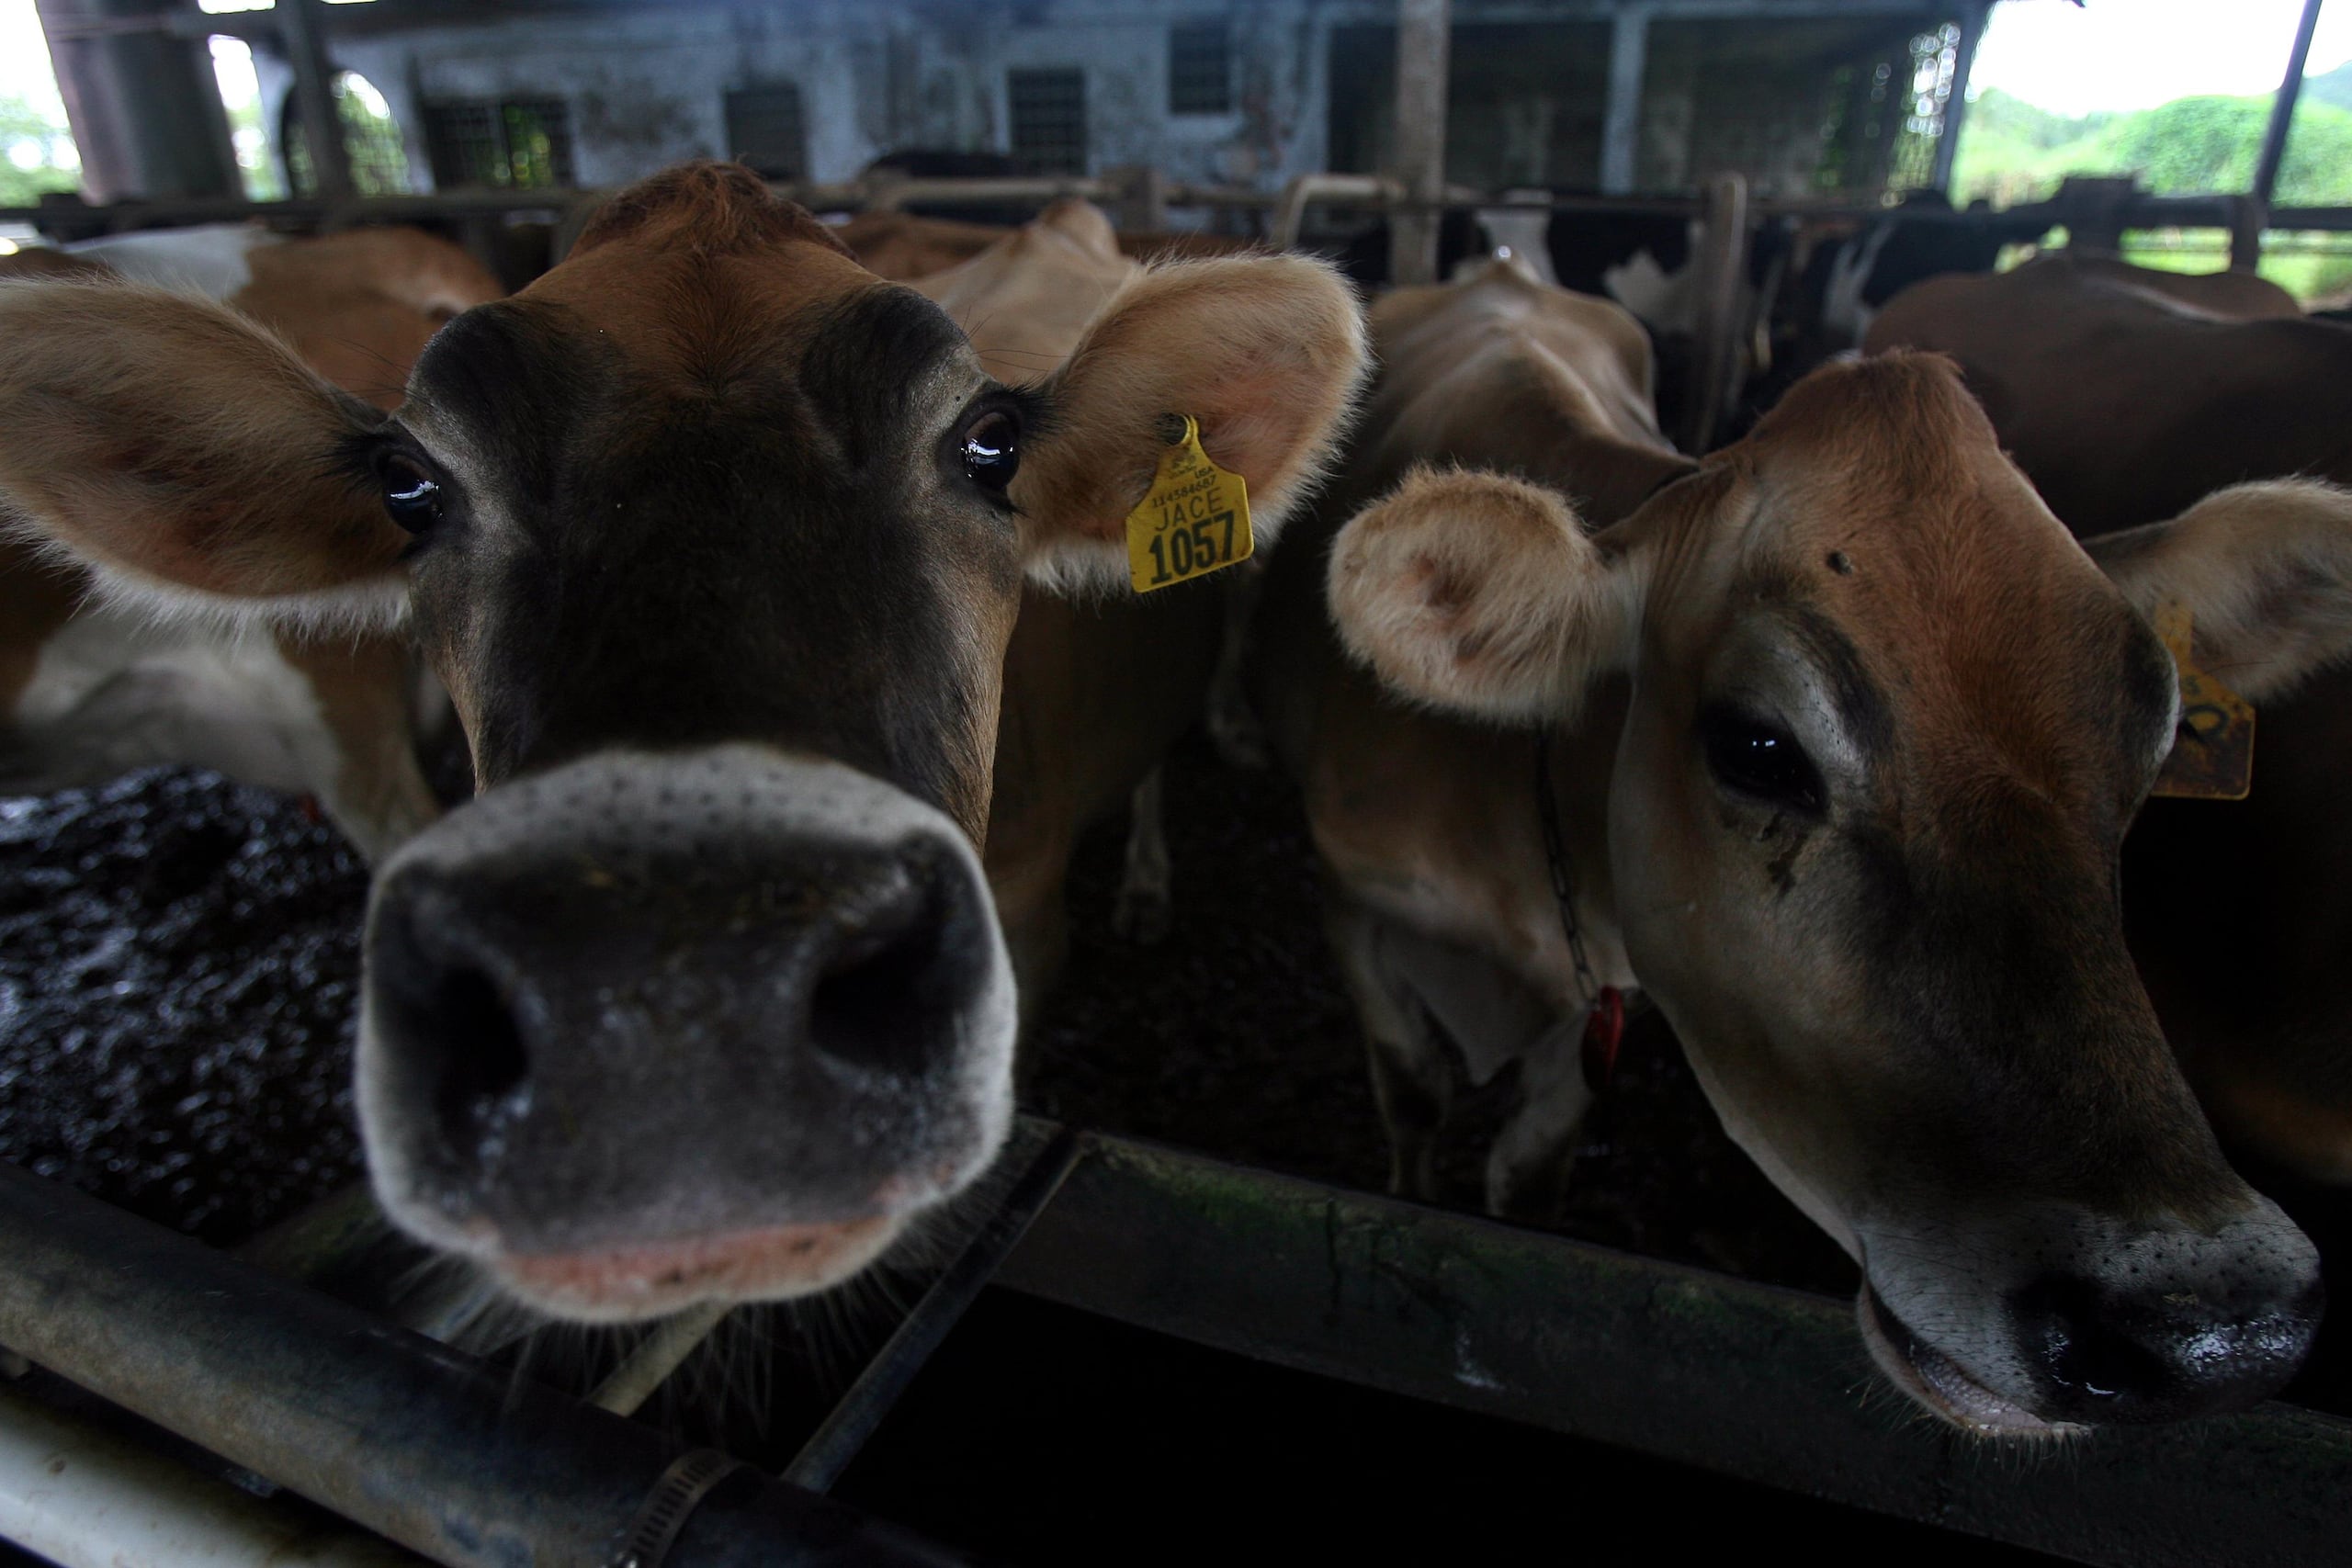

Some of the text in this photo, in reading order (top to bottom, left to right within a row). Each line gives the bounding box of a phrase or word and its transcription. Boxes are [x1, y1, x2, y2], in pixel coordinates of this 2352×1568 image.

[1194, 467, 1215, 479] USA
[1155, 487, 1224, 532] JACE
[1148, 510, 1235, 585] 1057
